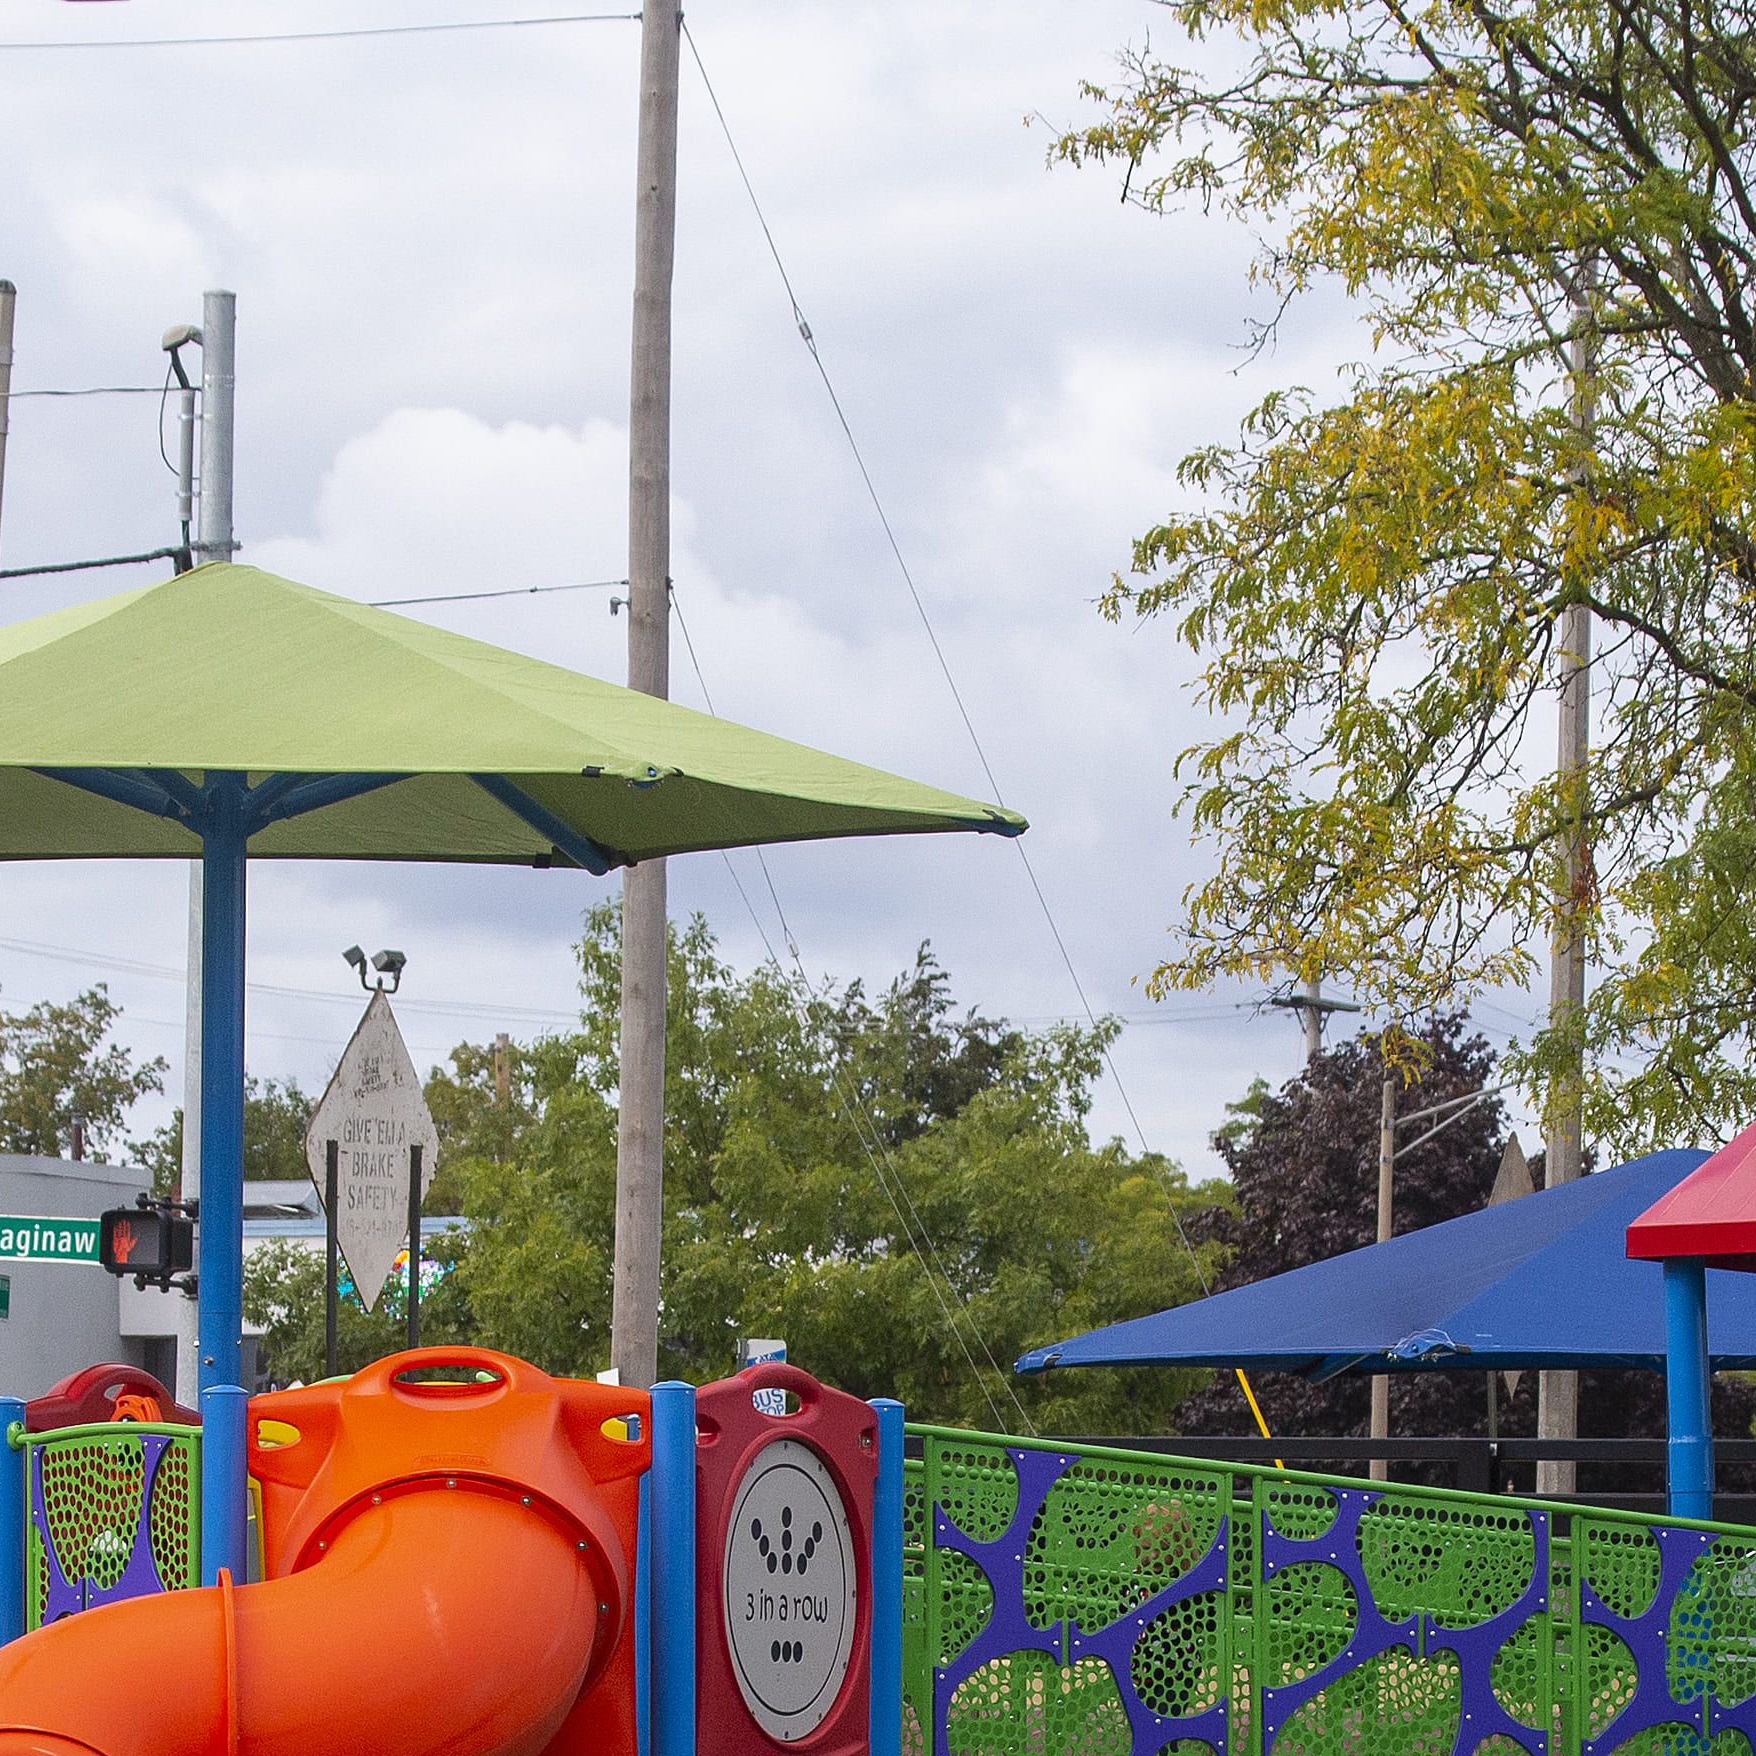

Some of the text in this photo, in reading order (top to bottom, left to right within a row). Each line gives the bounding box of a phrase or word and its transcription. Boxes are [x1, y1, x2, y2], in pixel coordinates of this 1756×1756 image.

[343, 1119, 371, 1143] GIVE
[352, 1151, 394, 1178] BRAKE
[347, 1185, 397, 1211] SAFETY
[753, 1388, 783, 1409] BUS
[745, 1588, 828, 1623] 3 in a row
